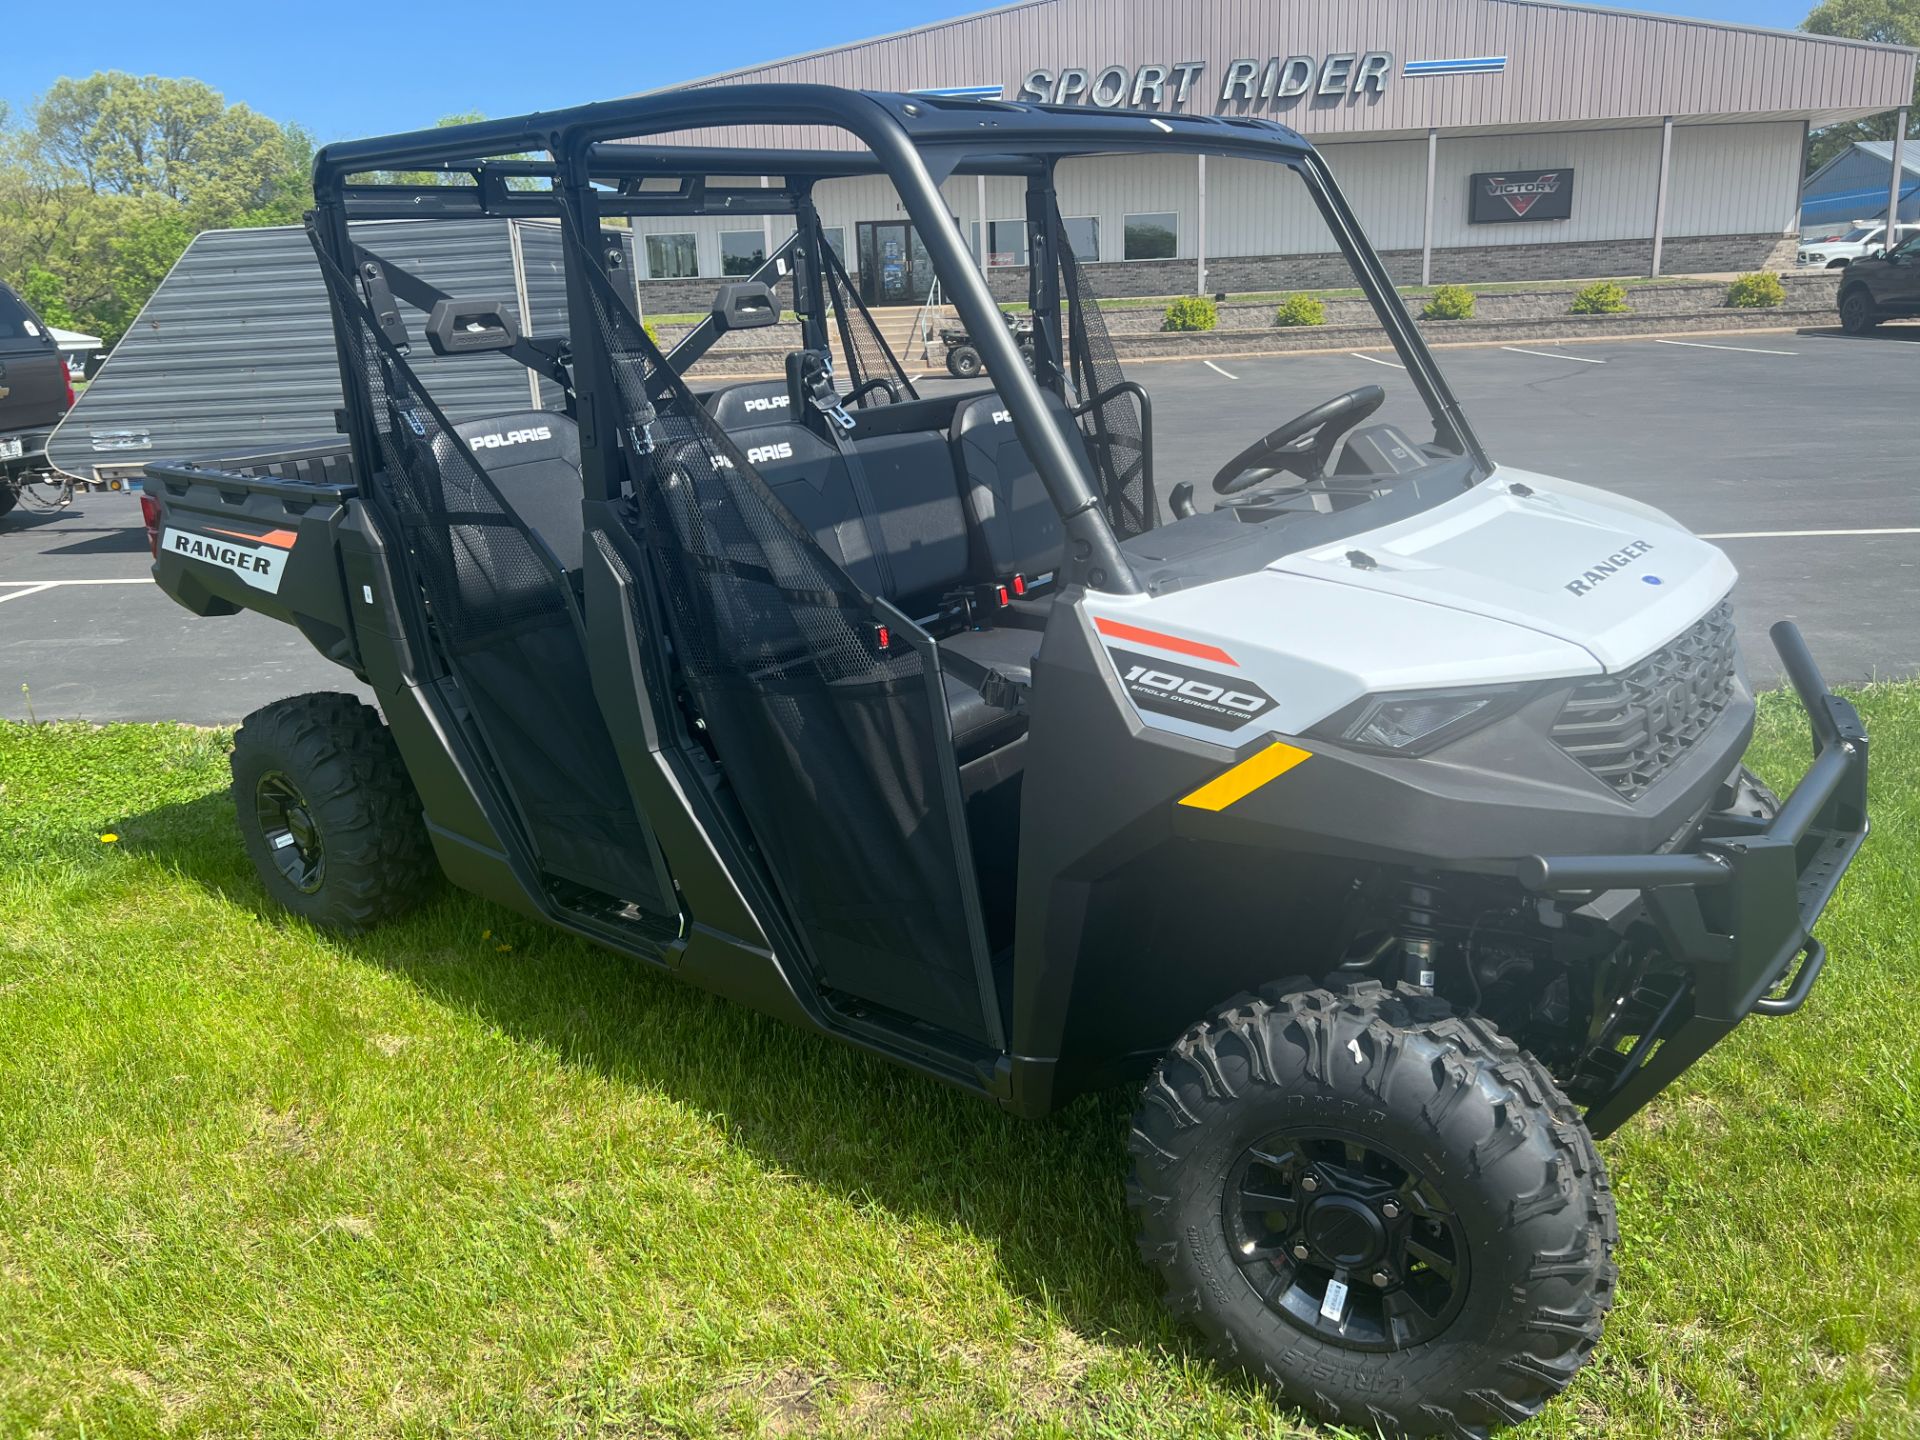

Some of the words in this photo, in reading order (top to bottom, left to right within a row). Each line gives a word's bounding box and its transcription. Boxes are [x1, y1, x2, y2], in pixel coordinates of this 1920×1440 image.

[1023, 61, 1206, 107] SPORT
[1223, 50, 1394, 100] RIDER
[1488, 182, 1558, 195] VICTORY
[744, 395, 790, 412] POLAR
[469, 426, 552, 451] POLARIS
[174, 535, 272, 575] RANGER
[1563, 539, 1655, 597] RANGER
[1124, 665, 1267, 712] 1000
[1131, 684, 1168, 698] SINGLE
[1170, 695, 1226, 713] OVERHEAD
[1226, 710, 1252, 720] CAM
